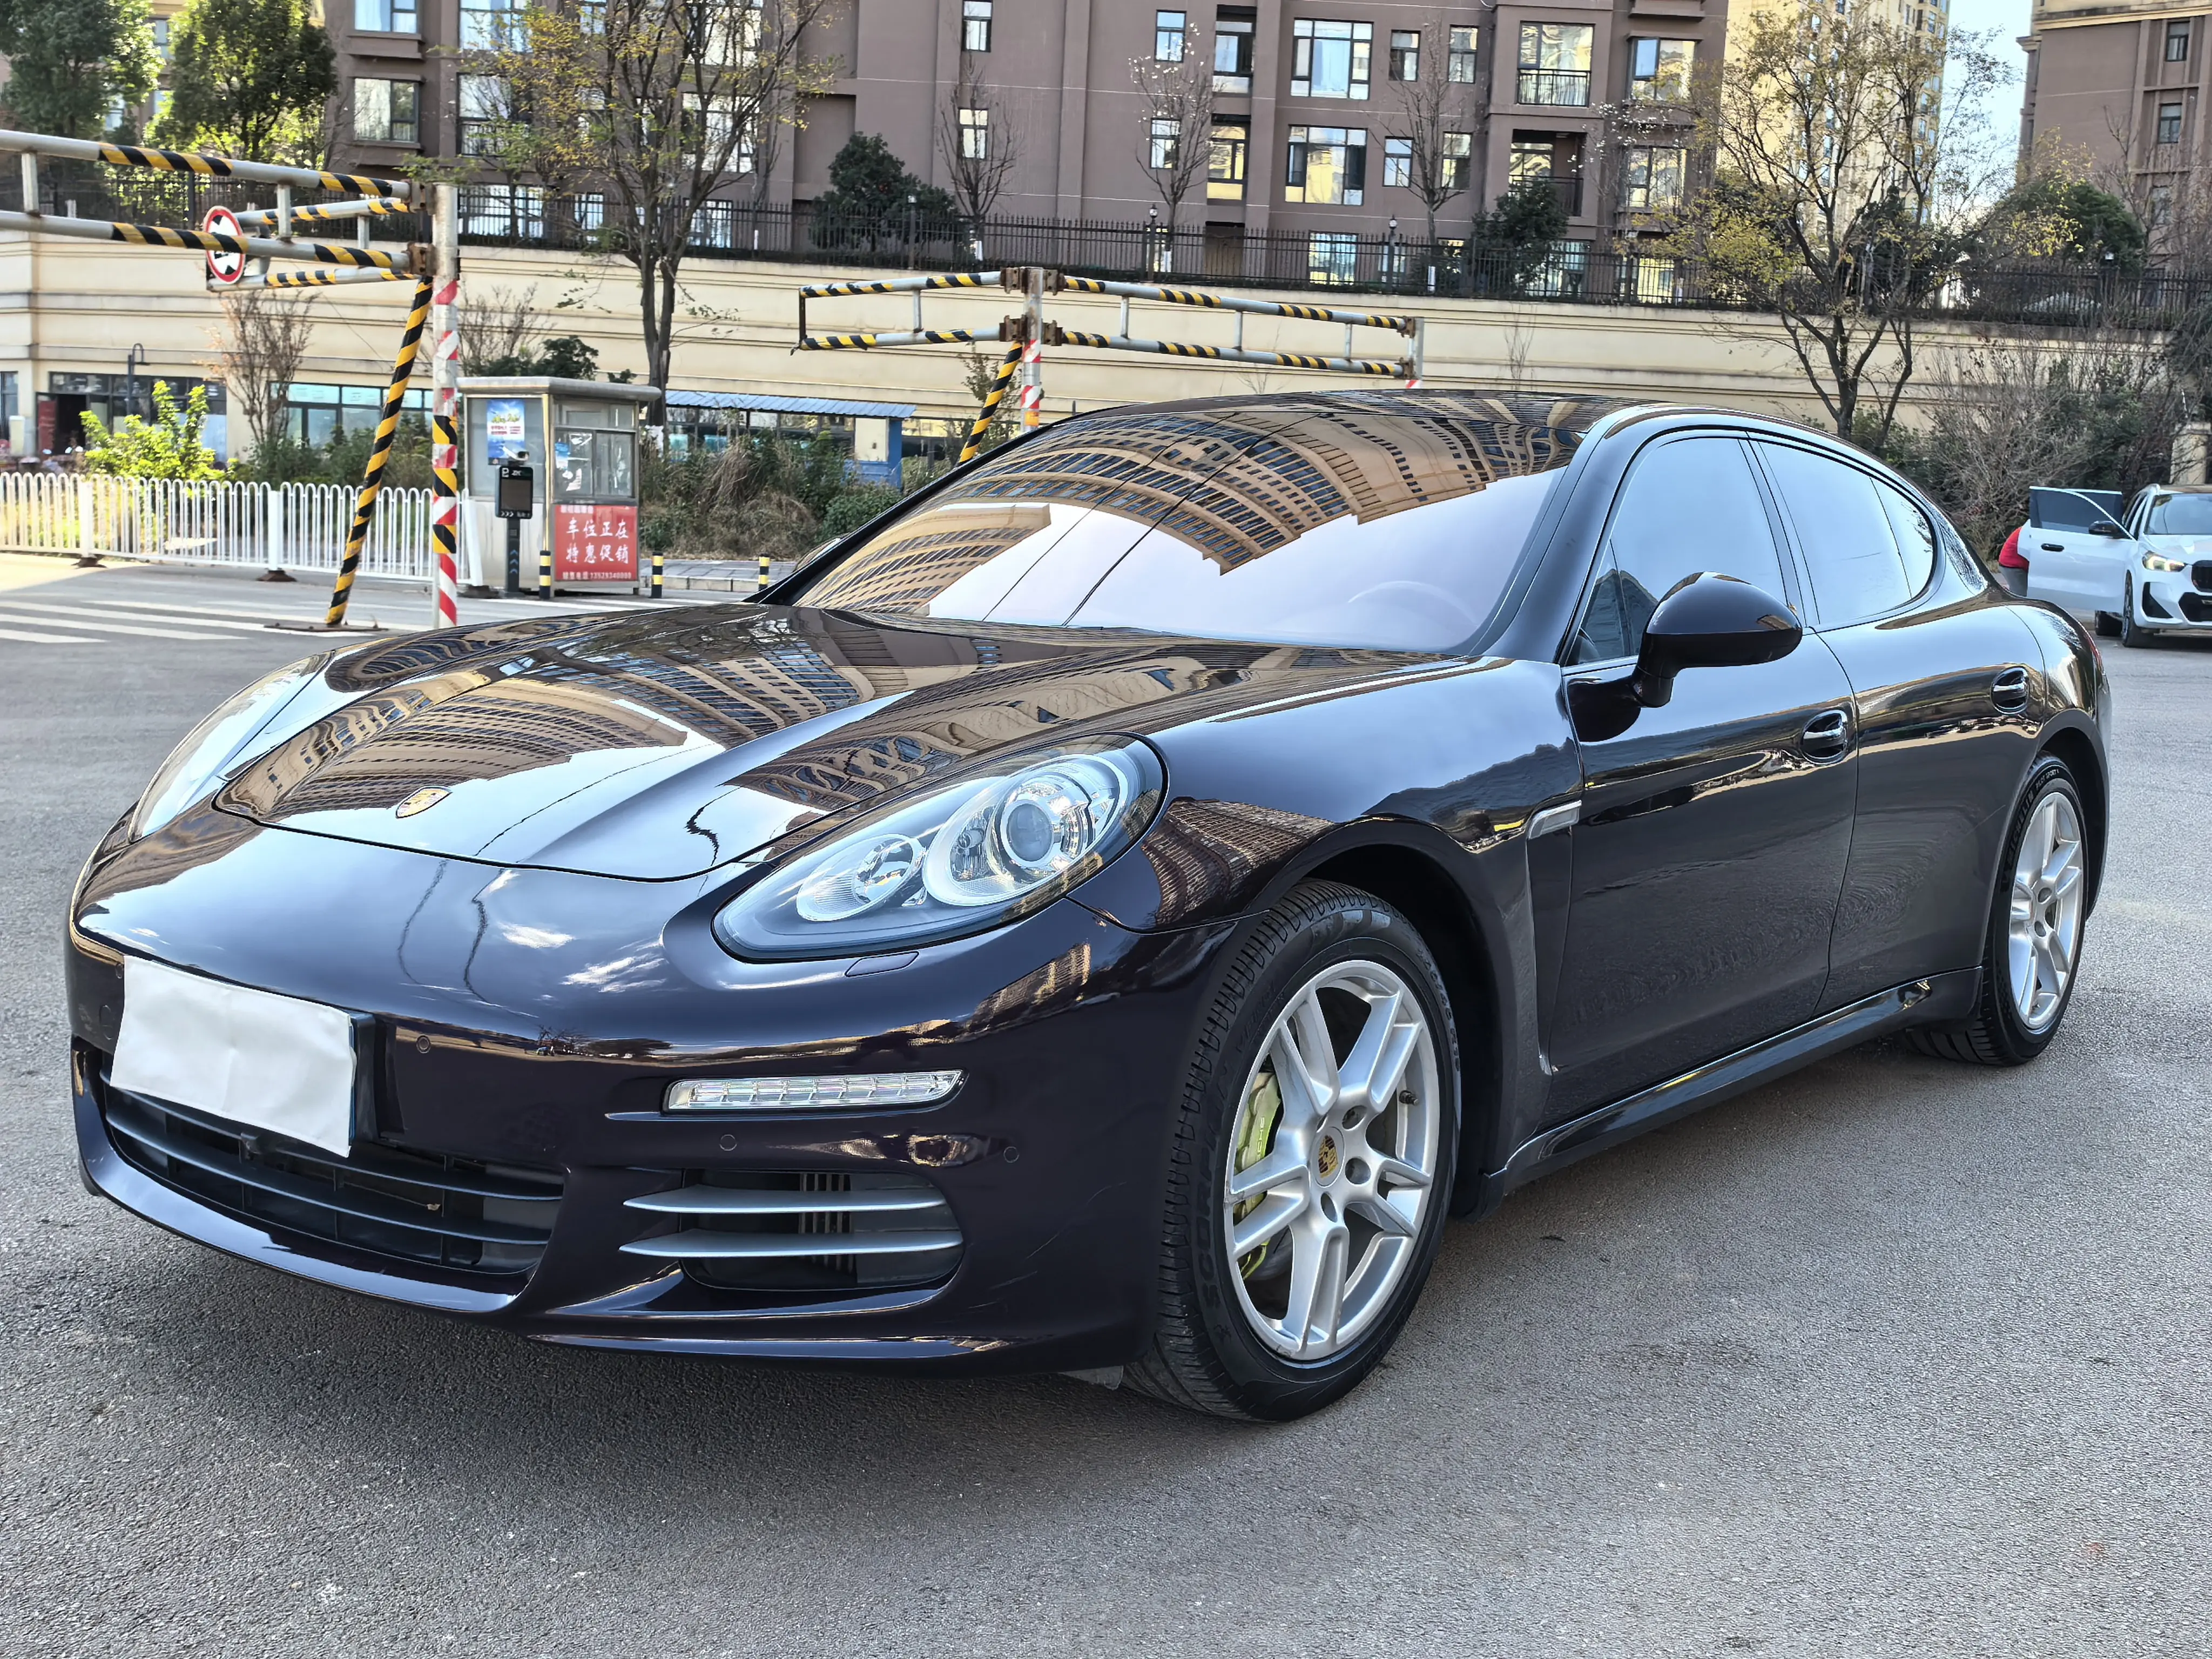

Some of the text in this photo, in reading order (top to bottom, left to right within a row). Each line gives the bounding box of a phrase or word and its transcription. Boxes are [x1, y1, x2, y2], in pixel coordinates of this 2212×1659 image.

[567, 517, 629, 539] 车位正在
[566, 542, 629, 564] 特惠促销
